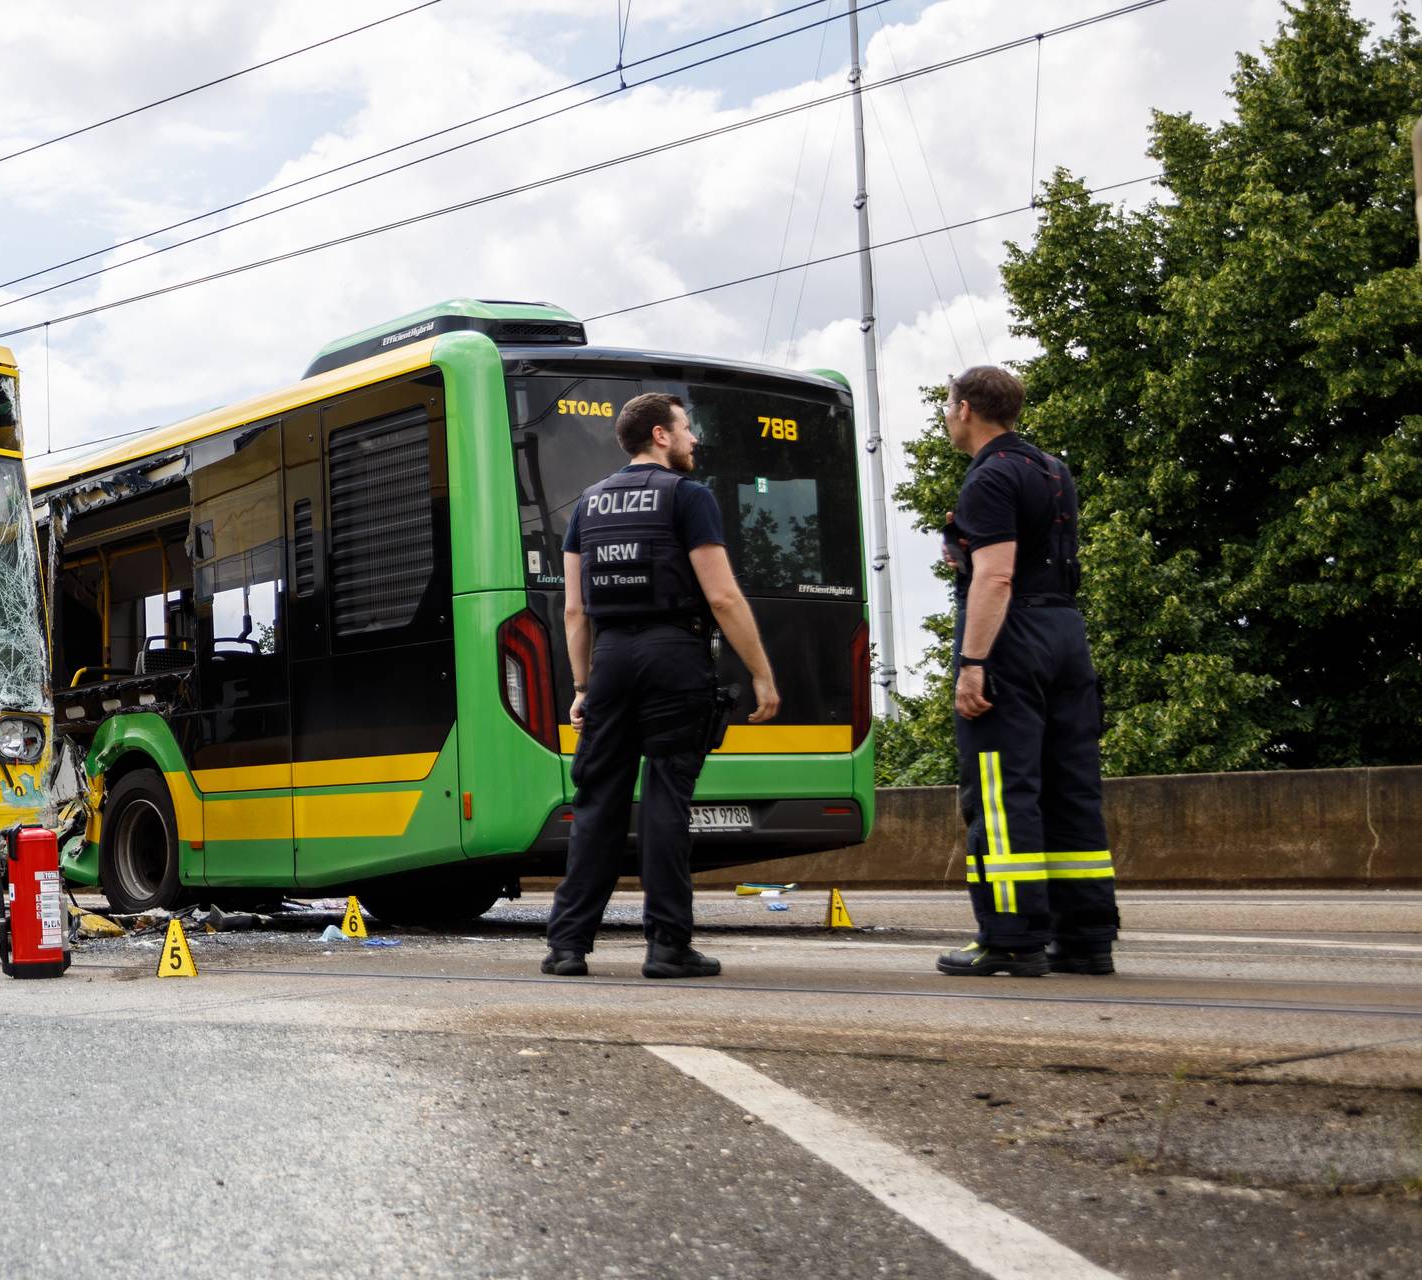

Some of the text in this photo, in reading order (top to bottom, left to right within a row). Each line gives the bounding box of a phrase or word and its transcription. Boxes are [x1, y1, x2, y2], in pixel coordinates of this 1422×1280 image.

[558, 399, 614, 417] STOAG
[758, 416, 798, 441] 788
[587, 489, 659, 516] POLIZEI
[597, 543, 639, 562] NRW
[537, 574, 565, 584] Lion's
[592, 575, 647, 586] VU Team
[798, 584, 854, 596] EfficientHybrid
[701, 807, 717, 824] ST
[719, 807, 750, 824] 9788
[349, 915, 358, 933] 6
[170, 946, 182, 970] 5
